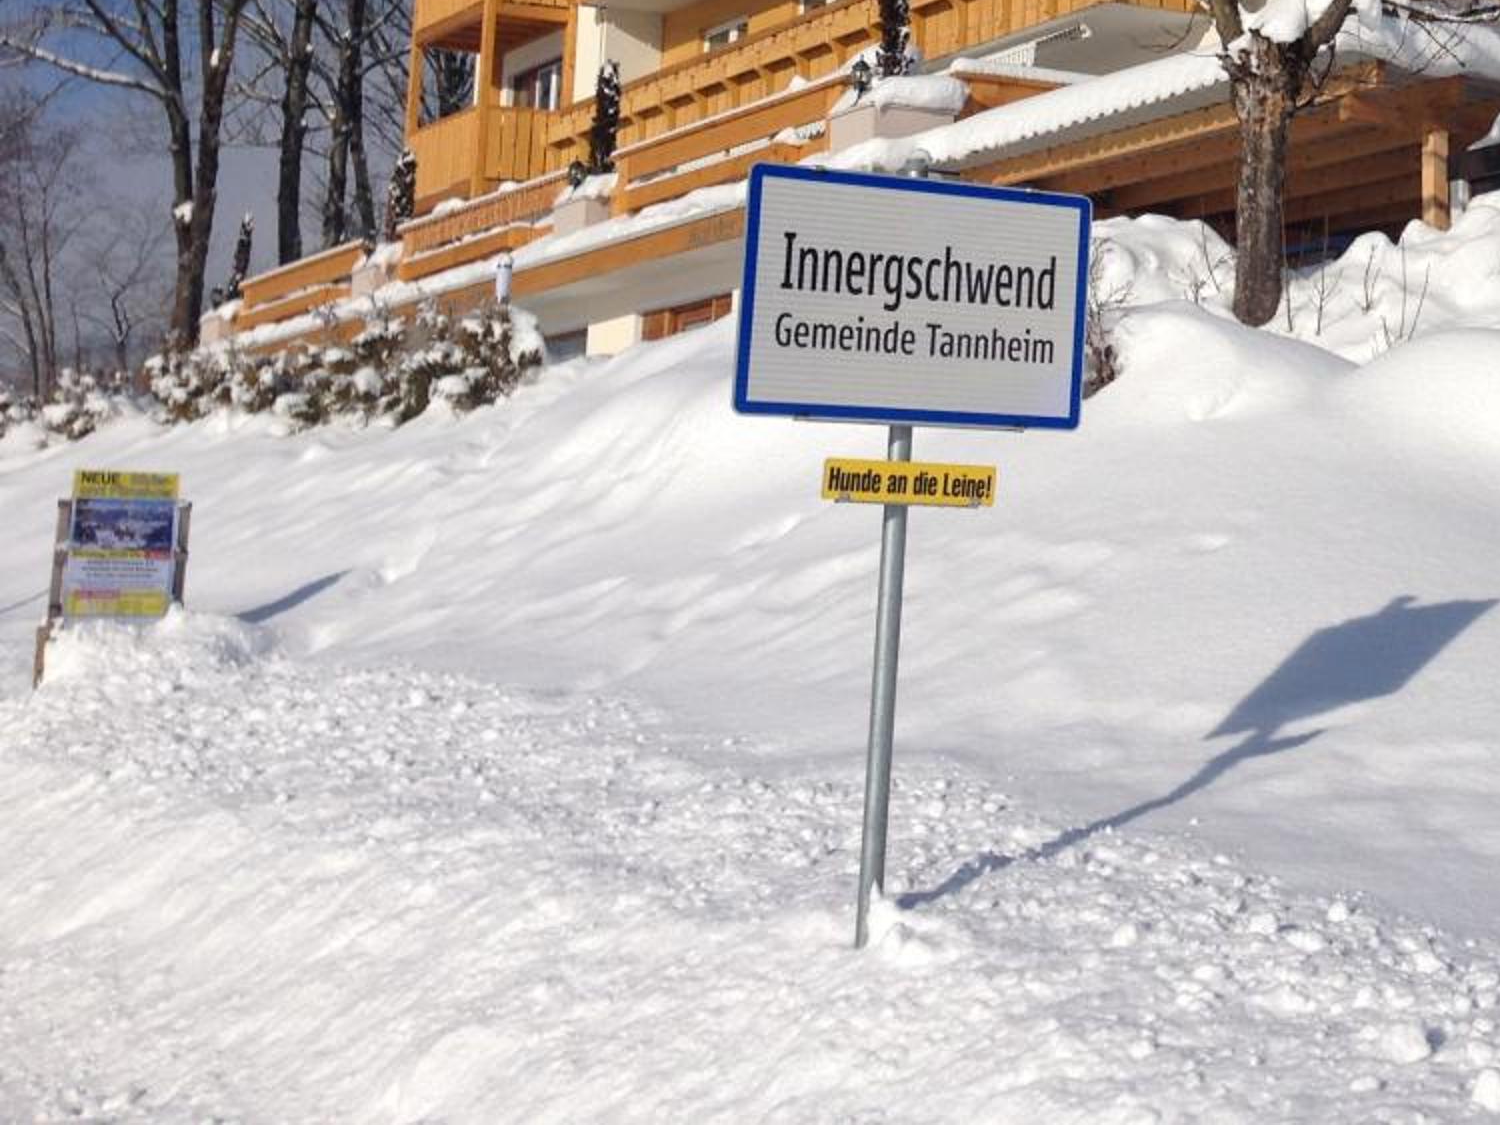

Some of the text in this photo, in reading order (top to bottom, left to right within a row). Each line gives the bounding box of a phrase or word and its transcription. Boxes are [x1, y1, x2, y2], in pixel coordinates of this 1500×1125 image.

[780, 231, 1058, 312] Innergschwend
[775, 312, 1055, 364] Gemeinde Tannheim
[81, 472, 120, 484] NEUE
[828, 467, 992, 499] Hunde an die Leine!
